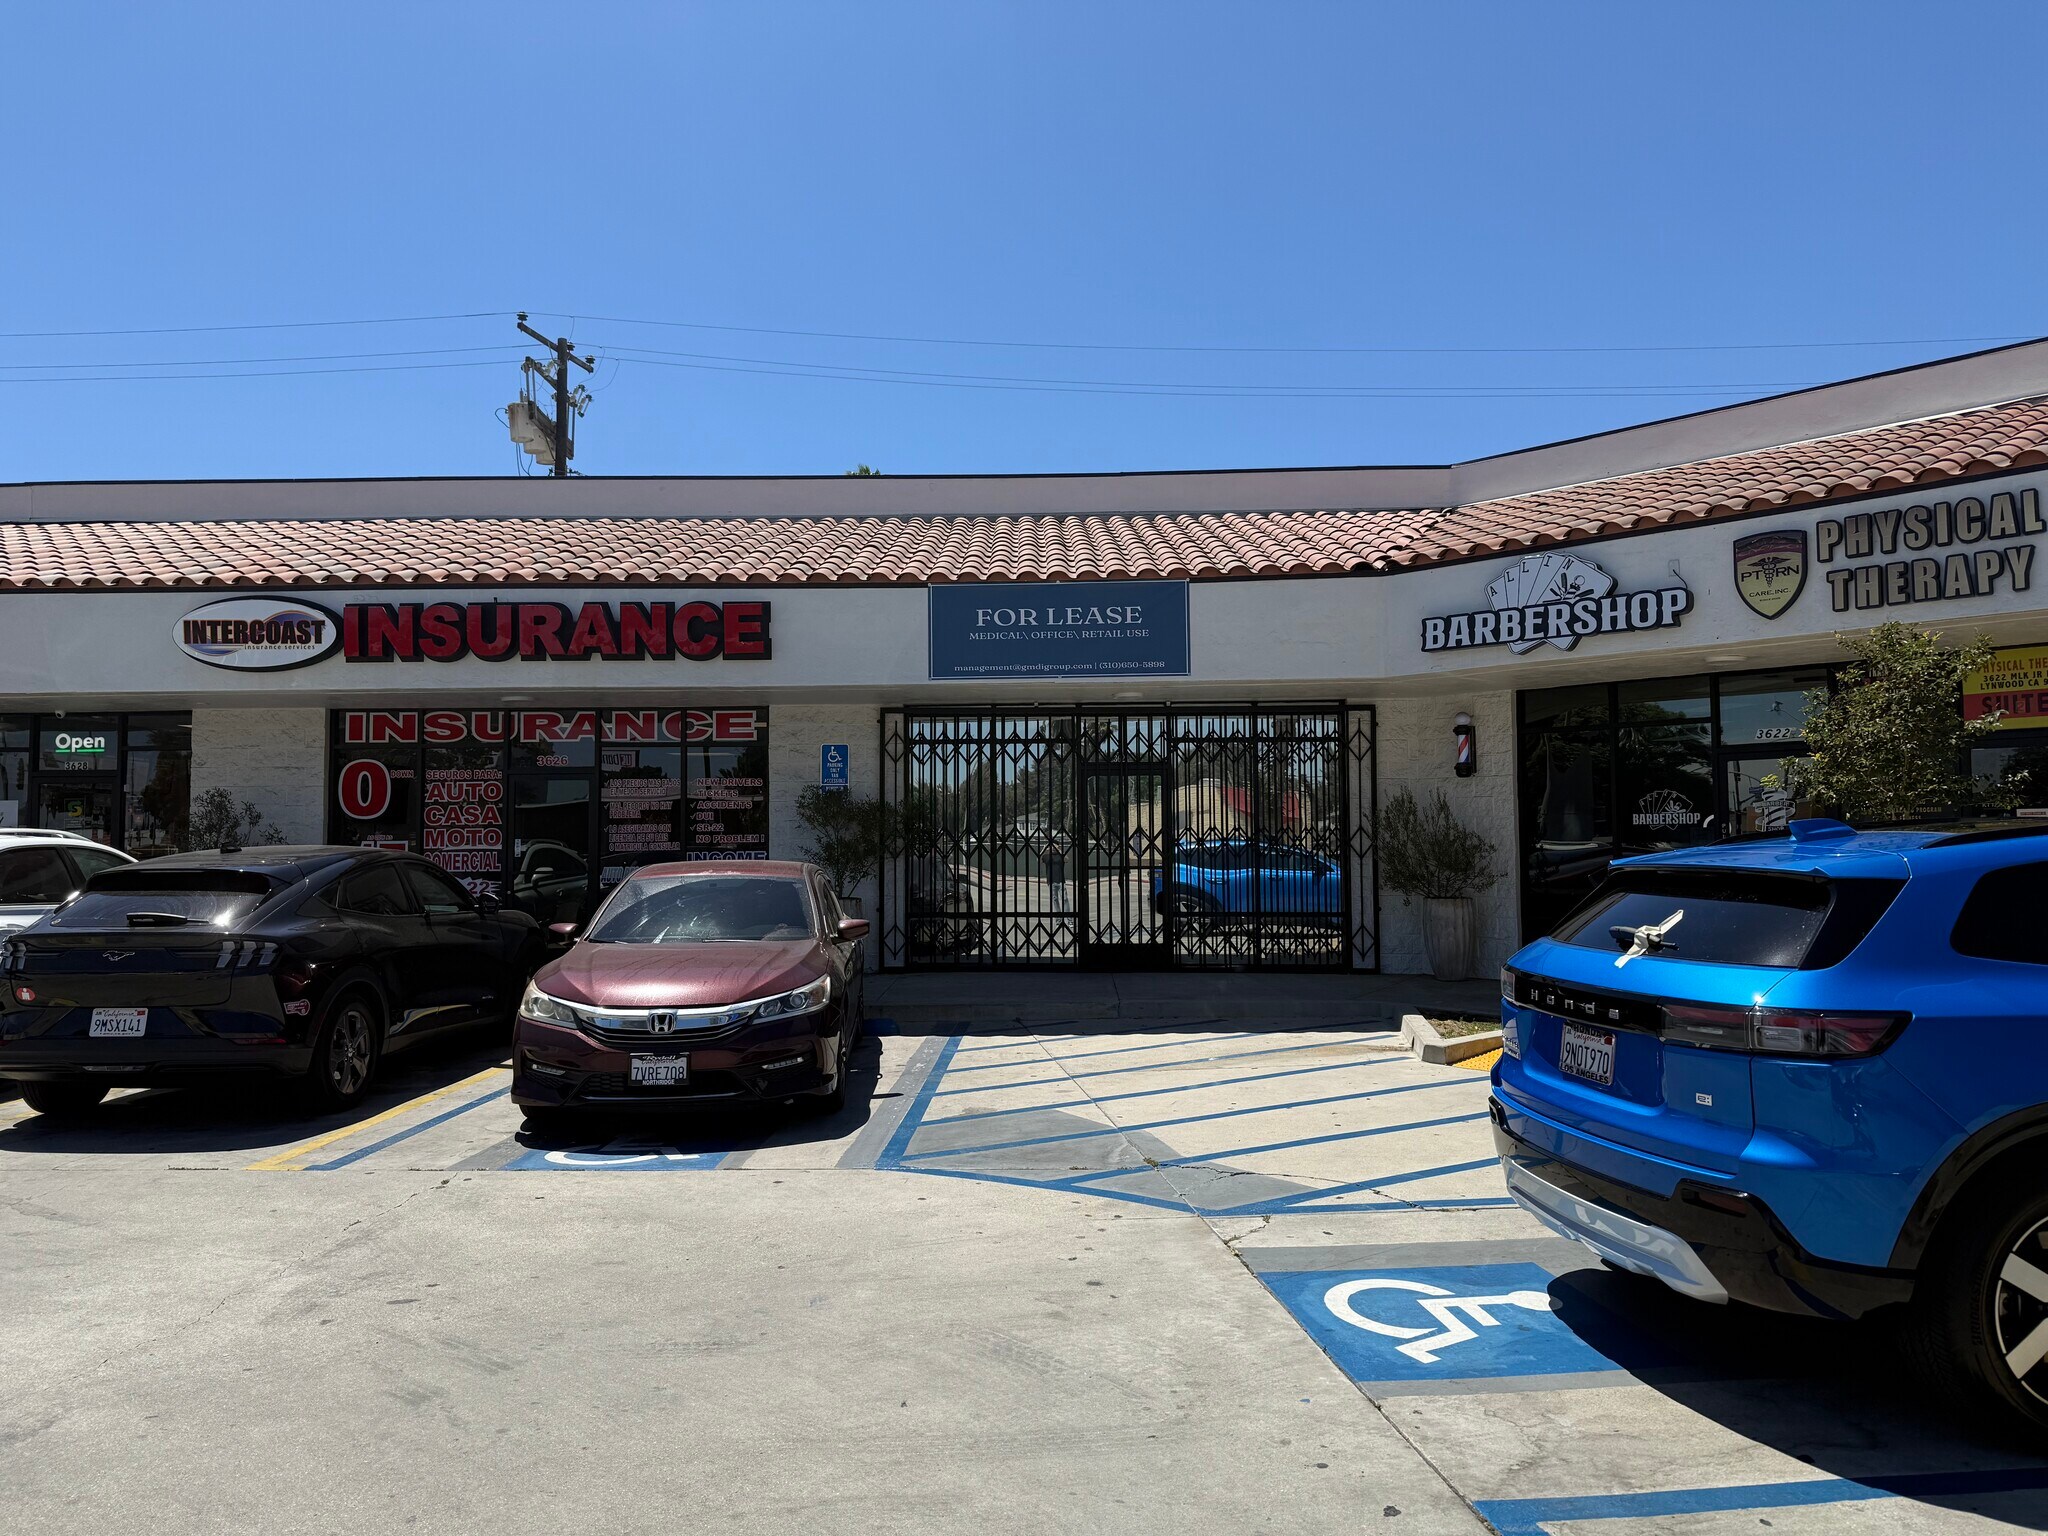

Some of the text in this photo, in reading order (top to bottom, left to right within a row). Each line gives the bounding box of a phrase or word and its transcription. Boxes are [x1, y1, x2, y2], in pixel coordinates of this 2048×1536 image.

[1816, 488, 2047, 562] PHYSICAL
[1826, 545, 2036, 612] THERAPY
[976, 606, 1143, 627] FOR LEASE
[1422, 588, 1690, 652] BARBERSHOP
[183, 617, 326, 645] INTERCOAST
[344, 601, 768, 659] INSURANCE
[1082, 629, 1124, 639] RETAIL
[1126, 629, 1150, 638] USE
[954, 662, 1093, 673] management@gmdigroup.com
[1099, 661, 1165, 670] (310)650-5898
[1983, 671, 2043, 683] 3622 MLK JR
[1980, 680, 2025, 691] LYNWOOD
[2028, 679, 2040, 687] CA
[345, 710, 758, 743] INSURANCE
[1756, 728, 1791, 739] 3622
[55, 733, 105, 752] Open
[65, 761, 88, 771] 3628
[537, 755, 568, 767] 3626
[426, 769, 471, 780] SEGUROS
[697, 777, 763, 787] NEW DRIVERS
[338, 758, 391, 820] 0
[425, 781, 503, 803] AUTO
[697, 789, 739, 798] TICKETS
[697, 800, 753, 810] ACCIDENTS
[424, 804, 503, 826] CASA
[696, 811, 714, 821] DUI
[1632, 812, 1701, 825] BARBERSHOP
[696, 823, 724, 833] SR-22
[424, 828, 503, 850] MOTO
[696, 834, 712, 844] NO
[712, 834, 760, 844] PROBLEM
[94, 1019, 141, 1032] 9MSX141
[1563, 1041, 1610, 1075] 9NOT970
[633, 1066, 685, 1080] 7VRE708
[1560, 1063, 1609, 1085] LOS ANGELES
